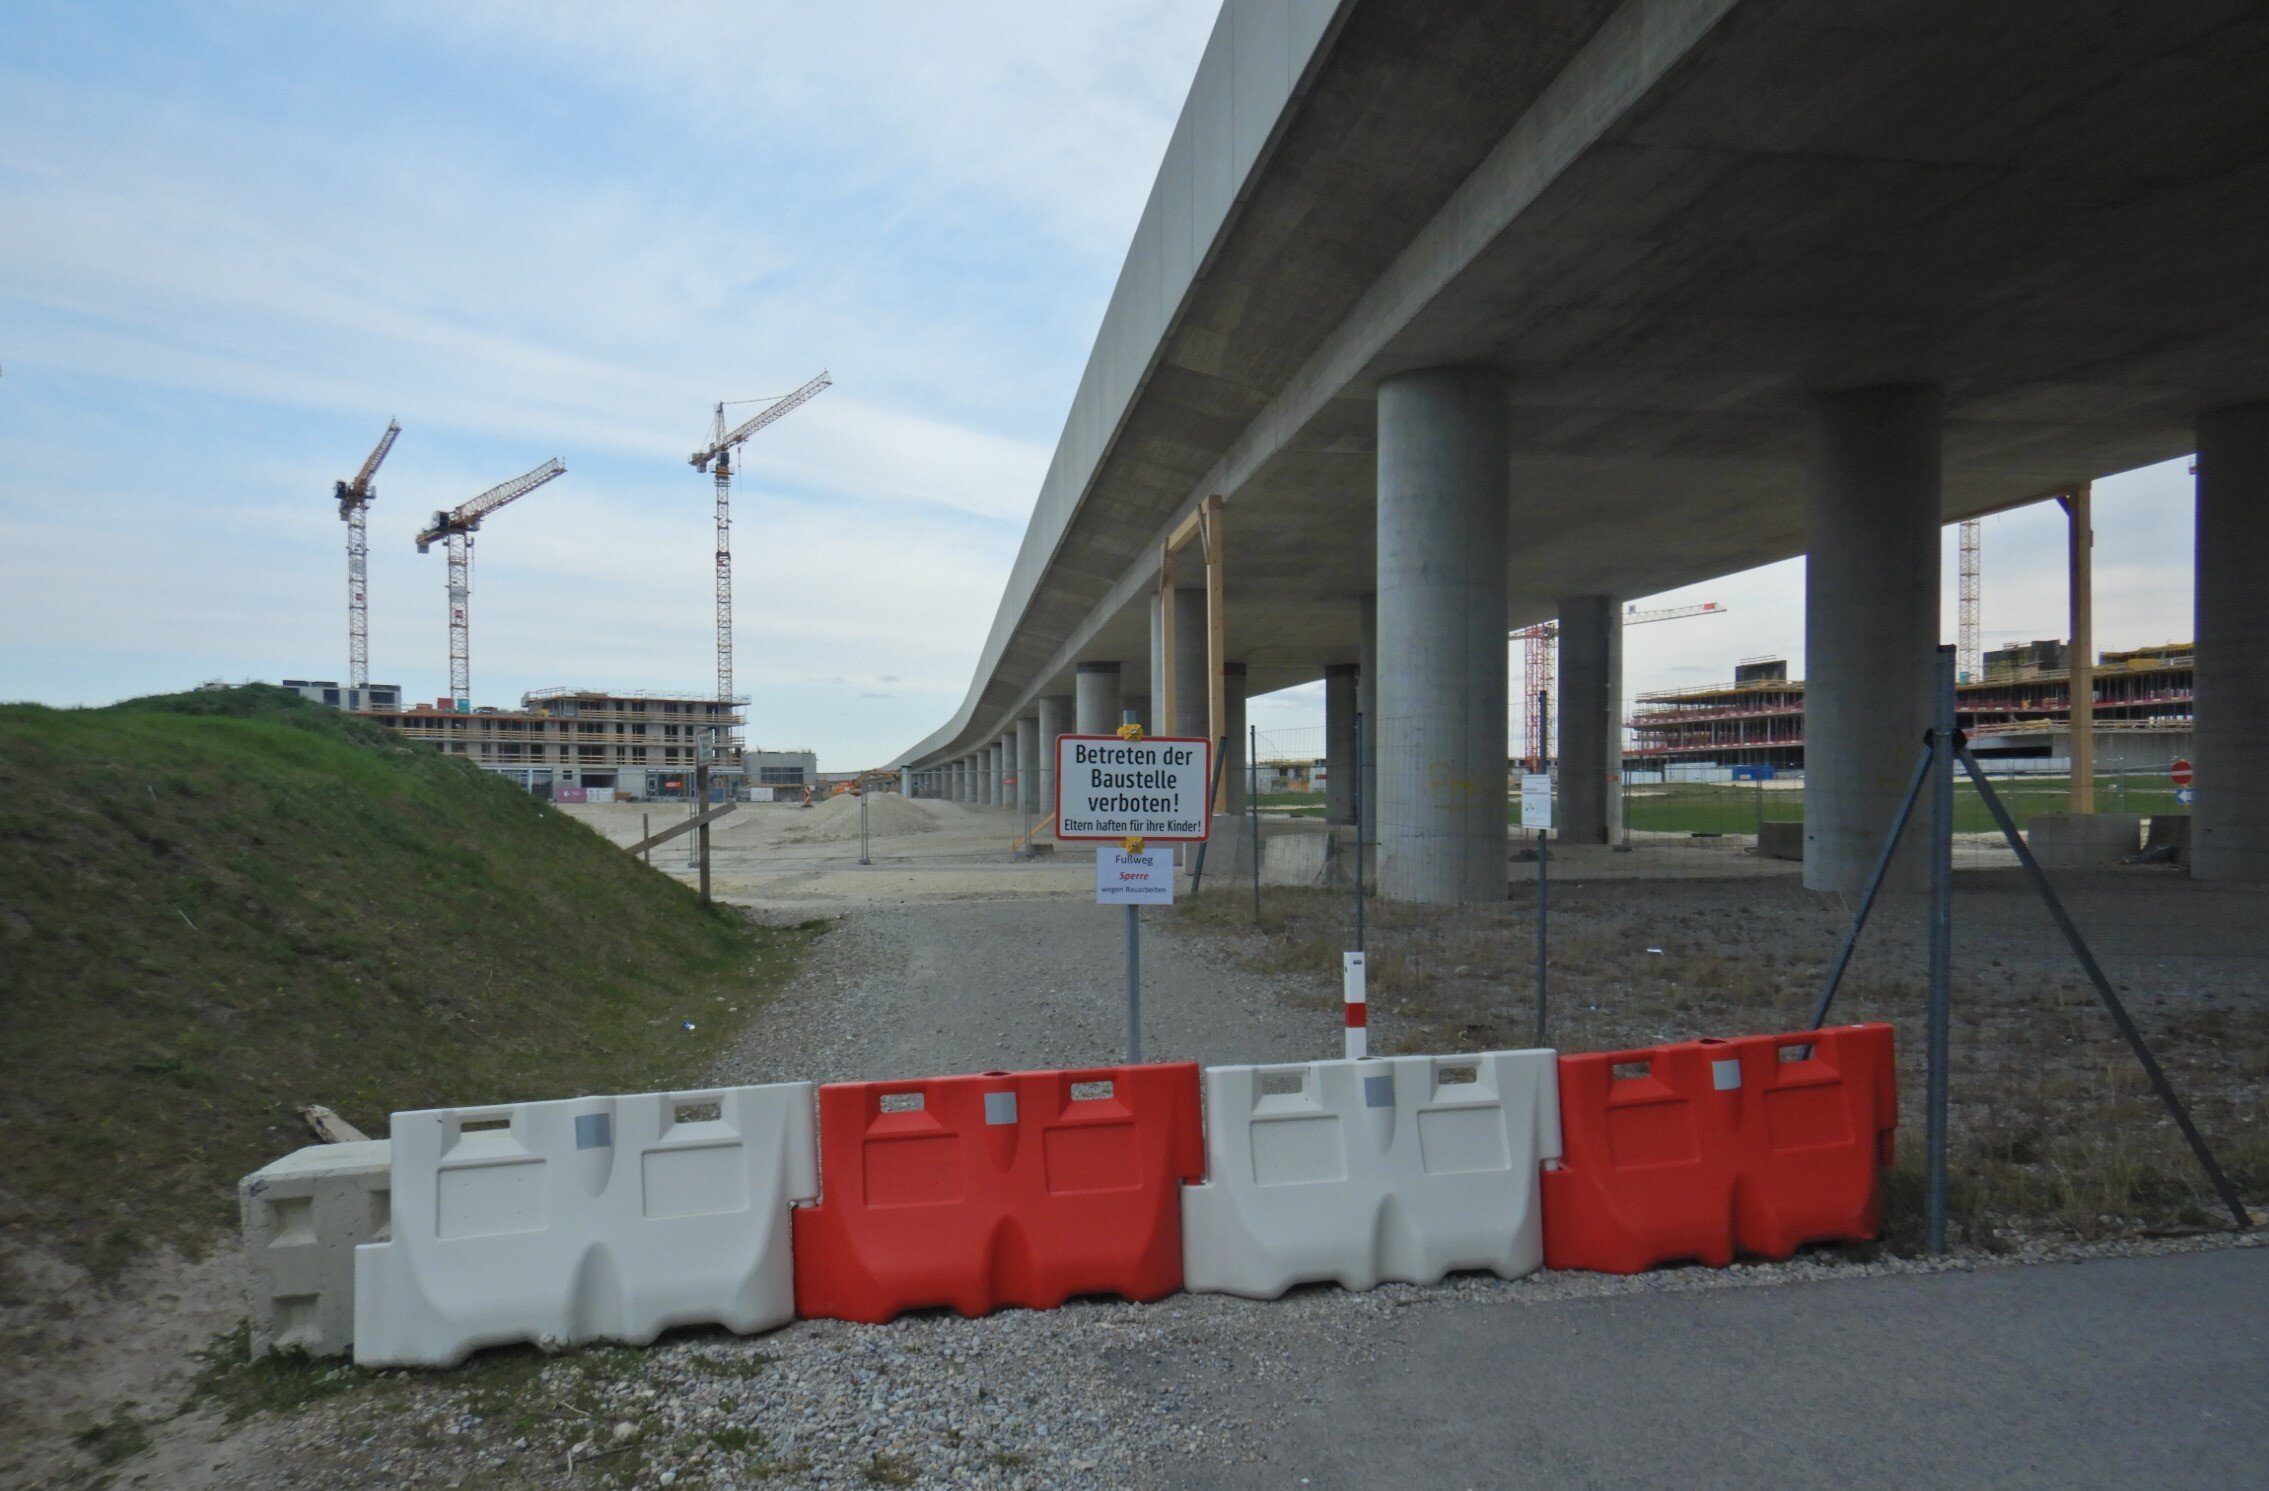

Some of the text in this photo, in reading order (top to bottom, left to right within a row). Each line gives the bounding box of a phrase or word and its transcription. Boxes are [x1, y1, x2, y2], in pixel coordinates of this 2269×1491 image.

[1076, 744, 1193, 766] Betreten der
[1091, 768, 1177, 789] Baustelle
[1088, 793, 1179, 812] verboten!
[1064, 819, 1201, 832] Eltern haften für ihre Kinder!
[1115, 855, 1153, 866] Fußweg
[1119, 871, 1149, 881] Sperre
[1101, 886, 1123, 894] wegen
